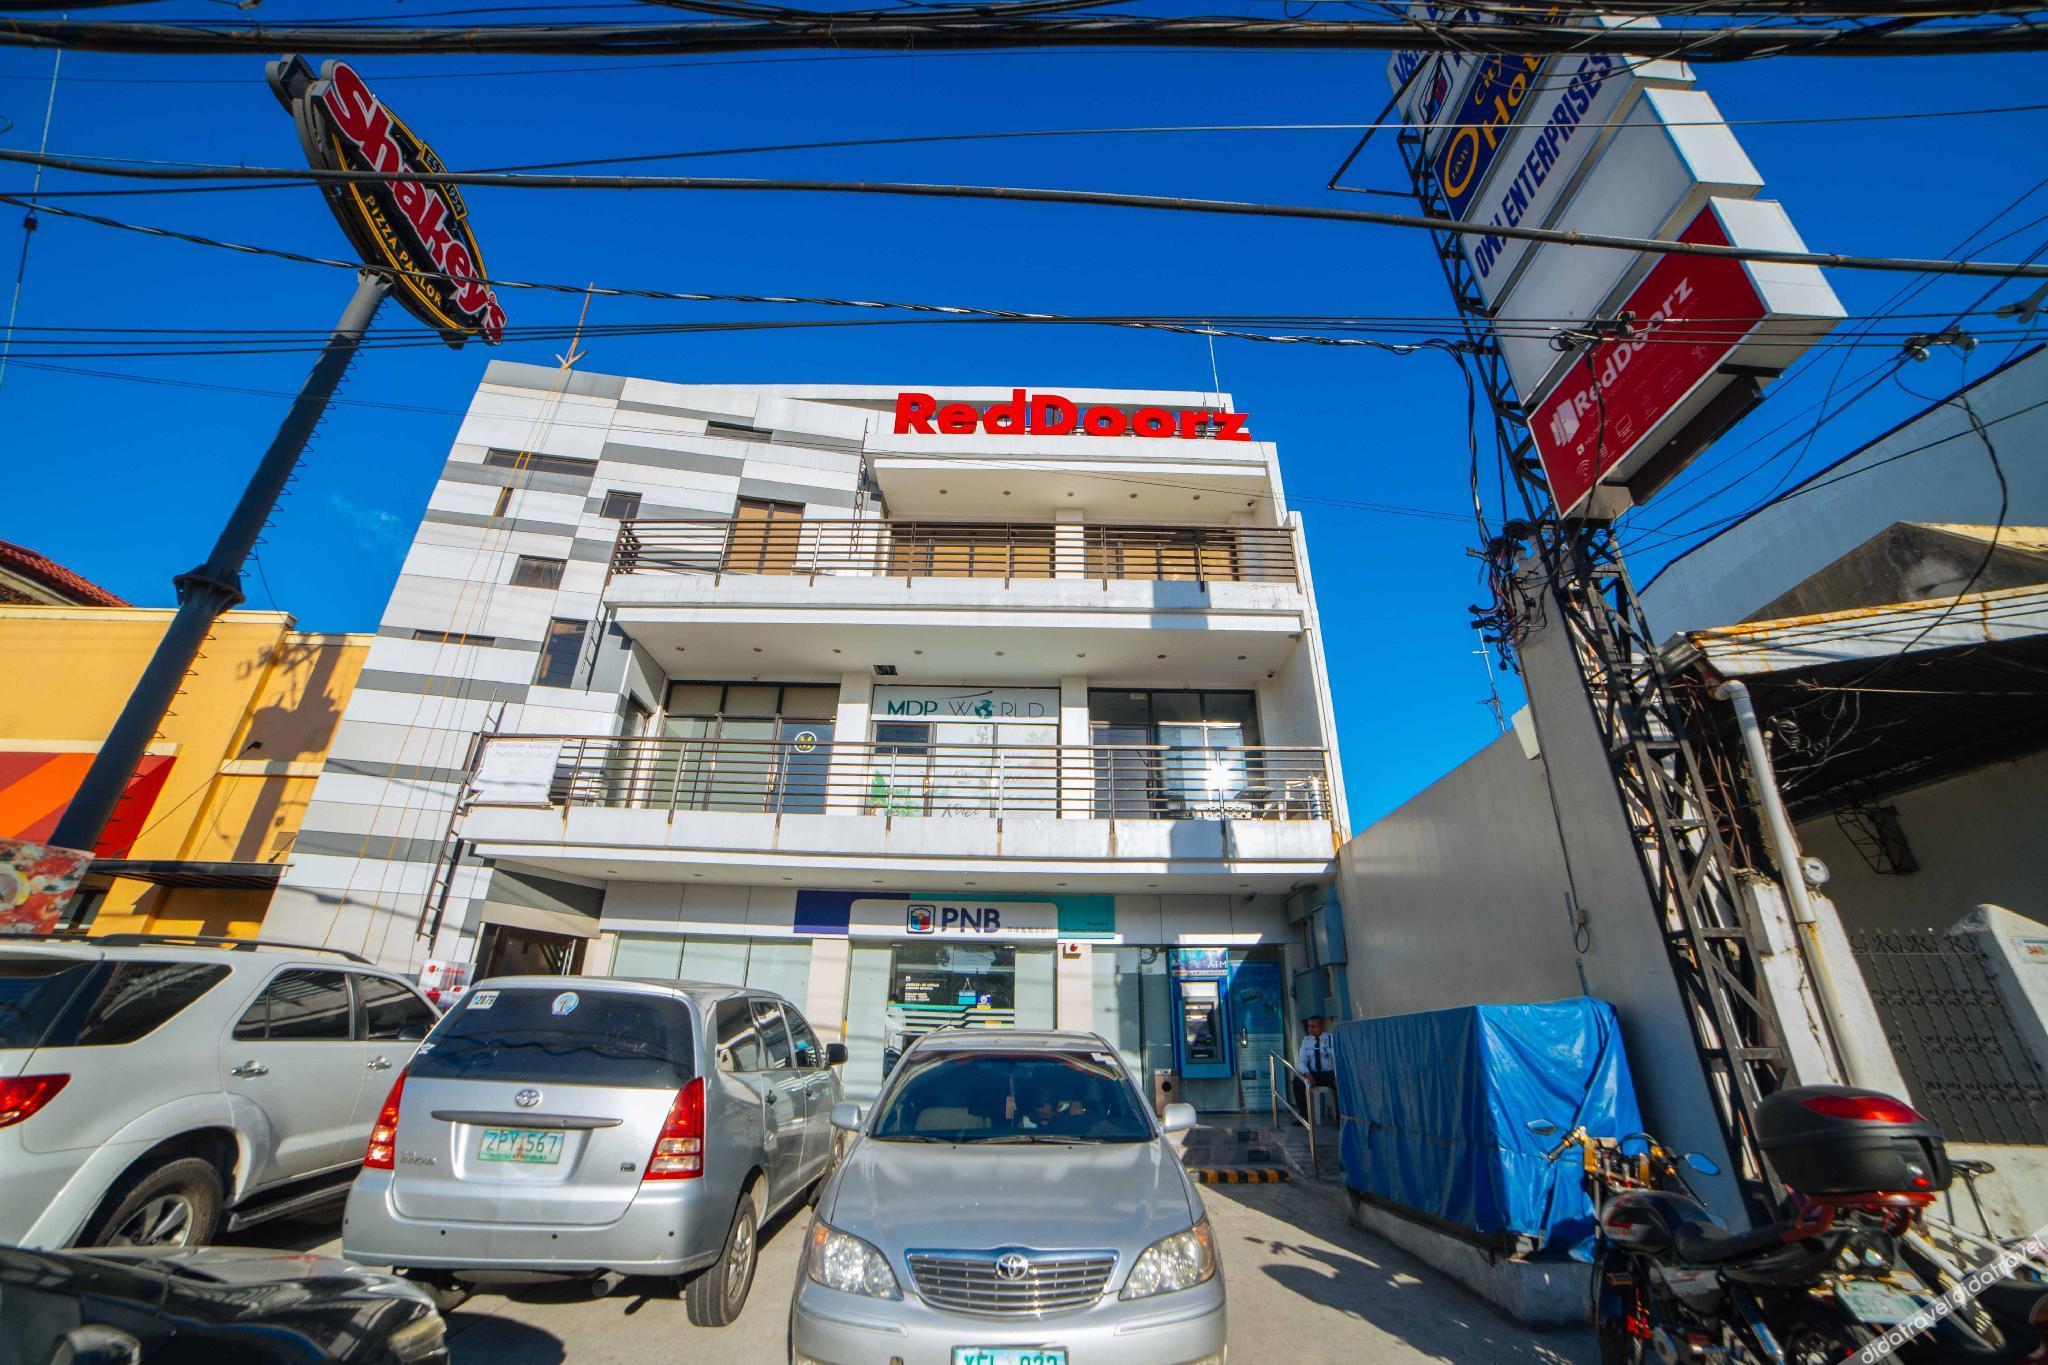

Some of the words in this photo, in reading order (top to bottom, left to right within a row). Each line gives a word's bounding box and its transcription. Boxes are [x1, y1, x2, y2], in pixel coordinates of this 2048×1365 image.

[1501, 51, 1612, 228] ENTERPRISES
[365, 195, 398, 250] PIZZA
[399, 250, 442, 306] PARLOR
[1573, 277, 1693, 417] RedDoorz
[893, 387, 1251, 441] RedDoorz
[887, 700, 938, 716] MDP
[941, 907, 1000, 933] PNB
[1207, 960, 1227, 969] ATM
[486, 1133, 519, 1151] ZPY
[525, 1134, 558, 1154] 567
